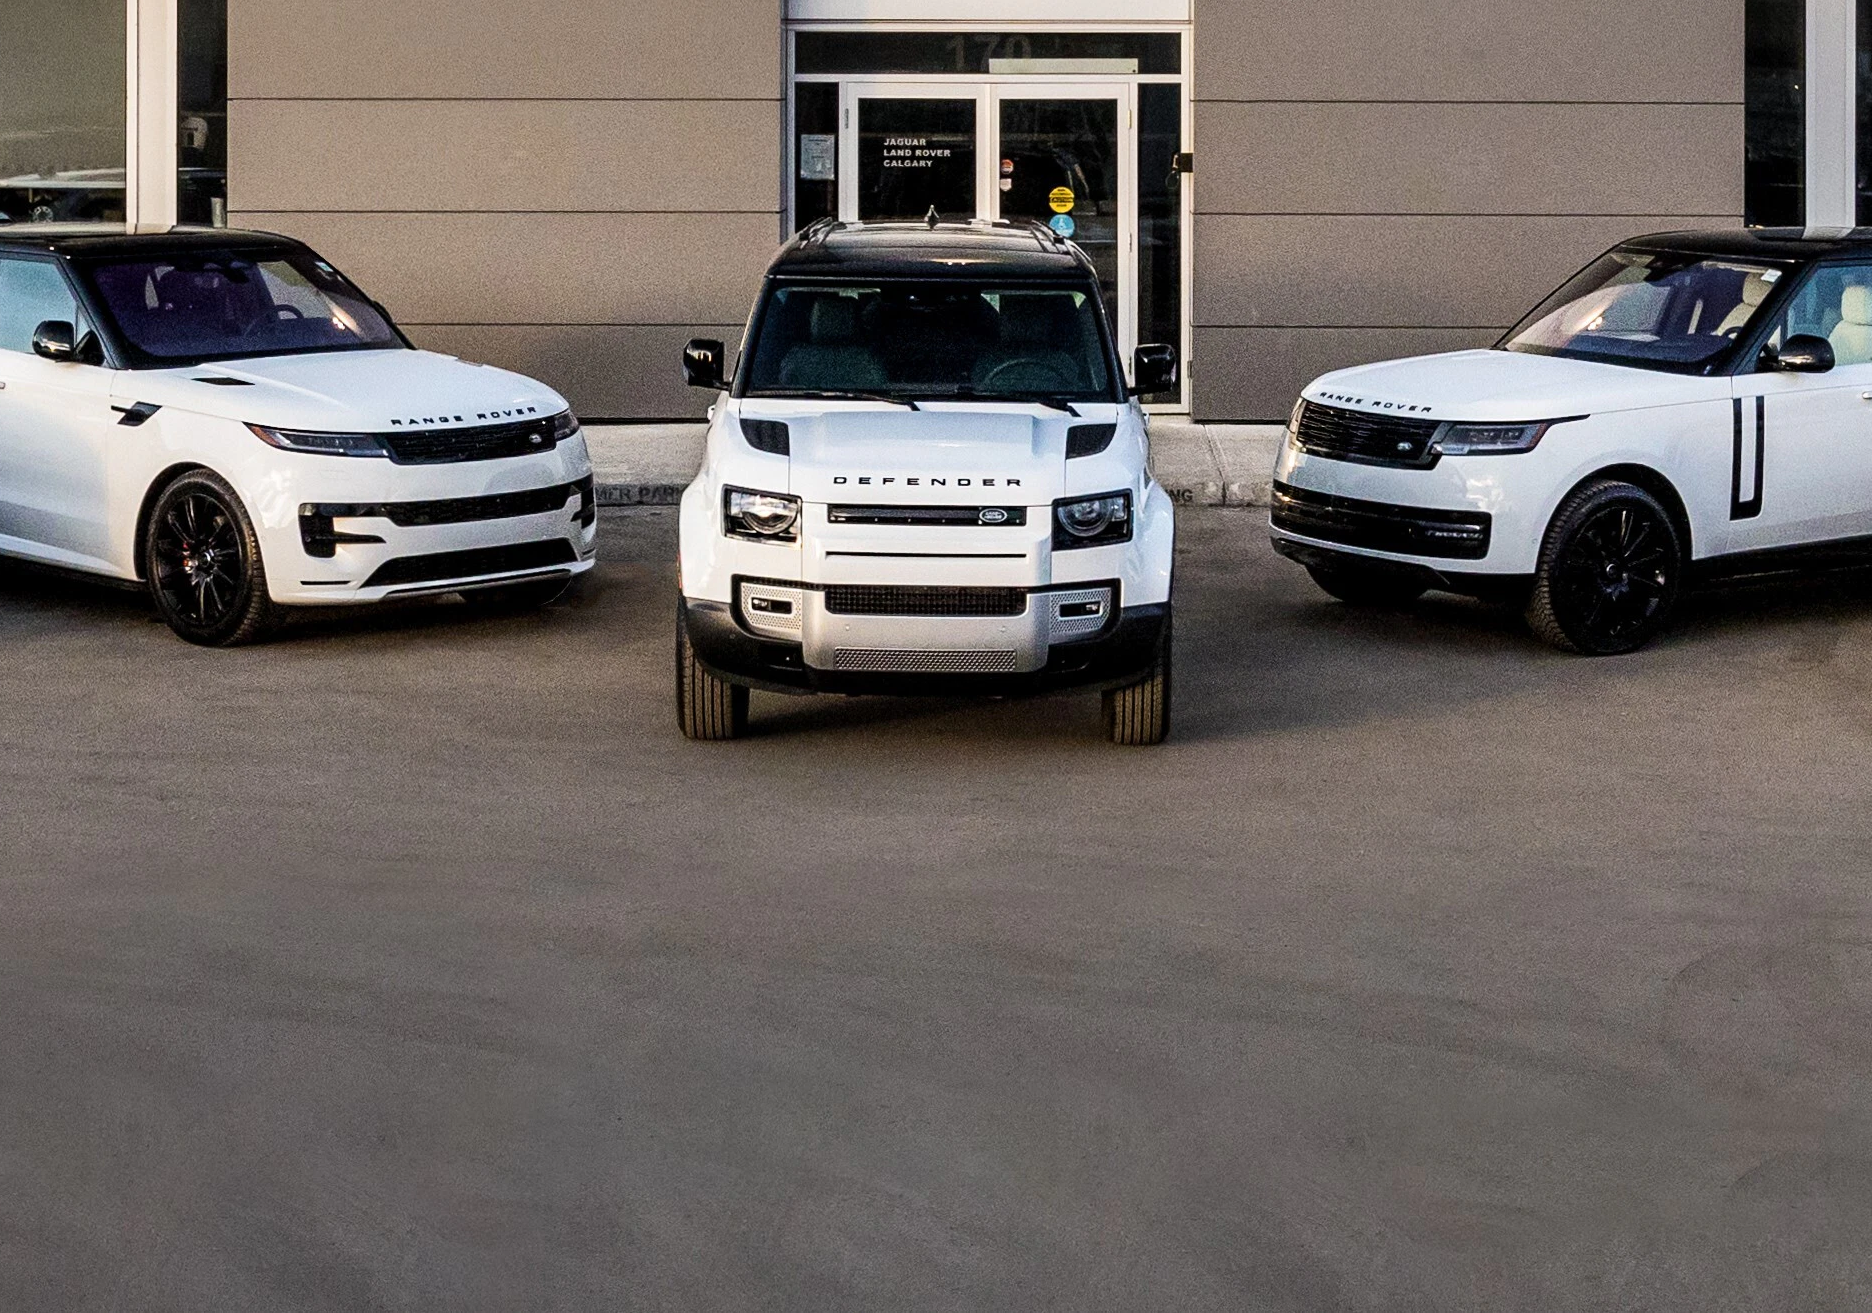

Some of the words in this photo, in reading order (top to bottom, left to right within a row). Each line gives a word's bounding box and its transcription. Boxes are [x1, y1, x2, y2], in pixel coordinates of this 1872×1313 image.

[883, 138, 927, 146] JAGUAR
[883, 149, 912, 157] LAND
[915, 149, 951, 157] ROVER
[883, 159, 933, 167] CALGARY
[1319, 391, 1364, 405] RANGE
[1371, 400, 1432, 413] ROVER
[390, 415, 464, 426] RANGE
[476, 406, 537, 420] ROVER
[833, 476, 1021, 487] DEFENDER
